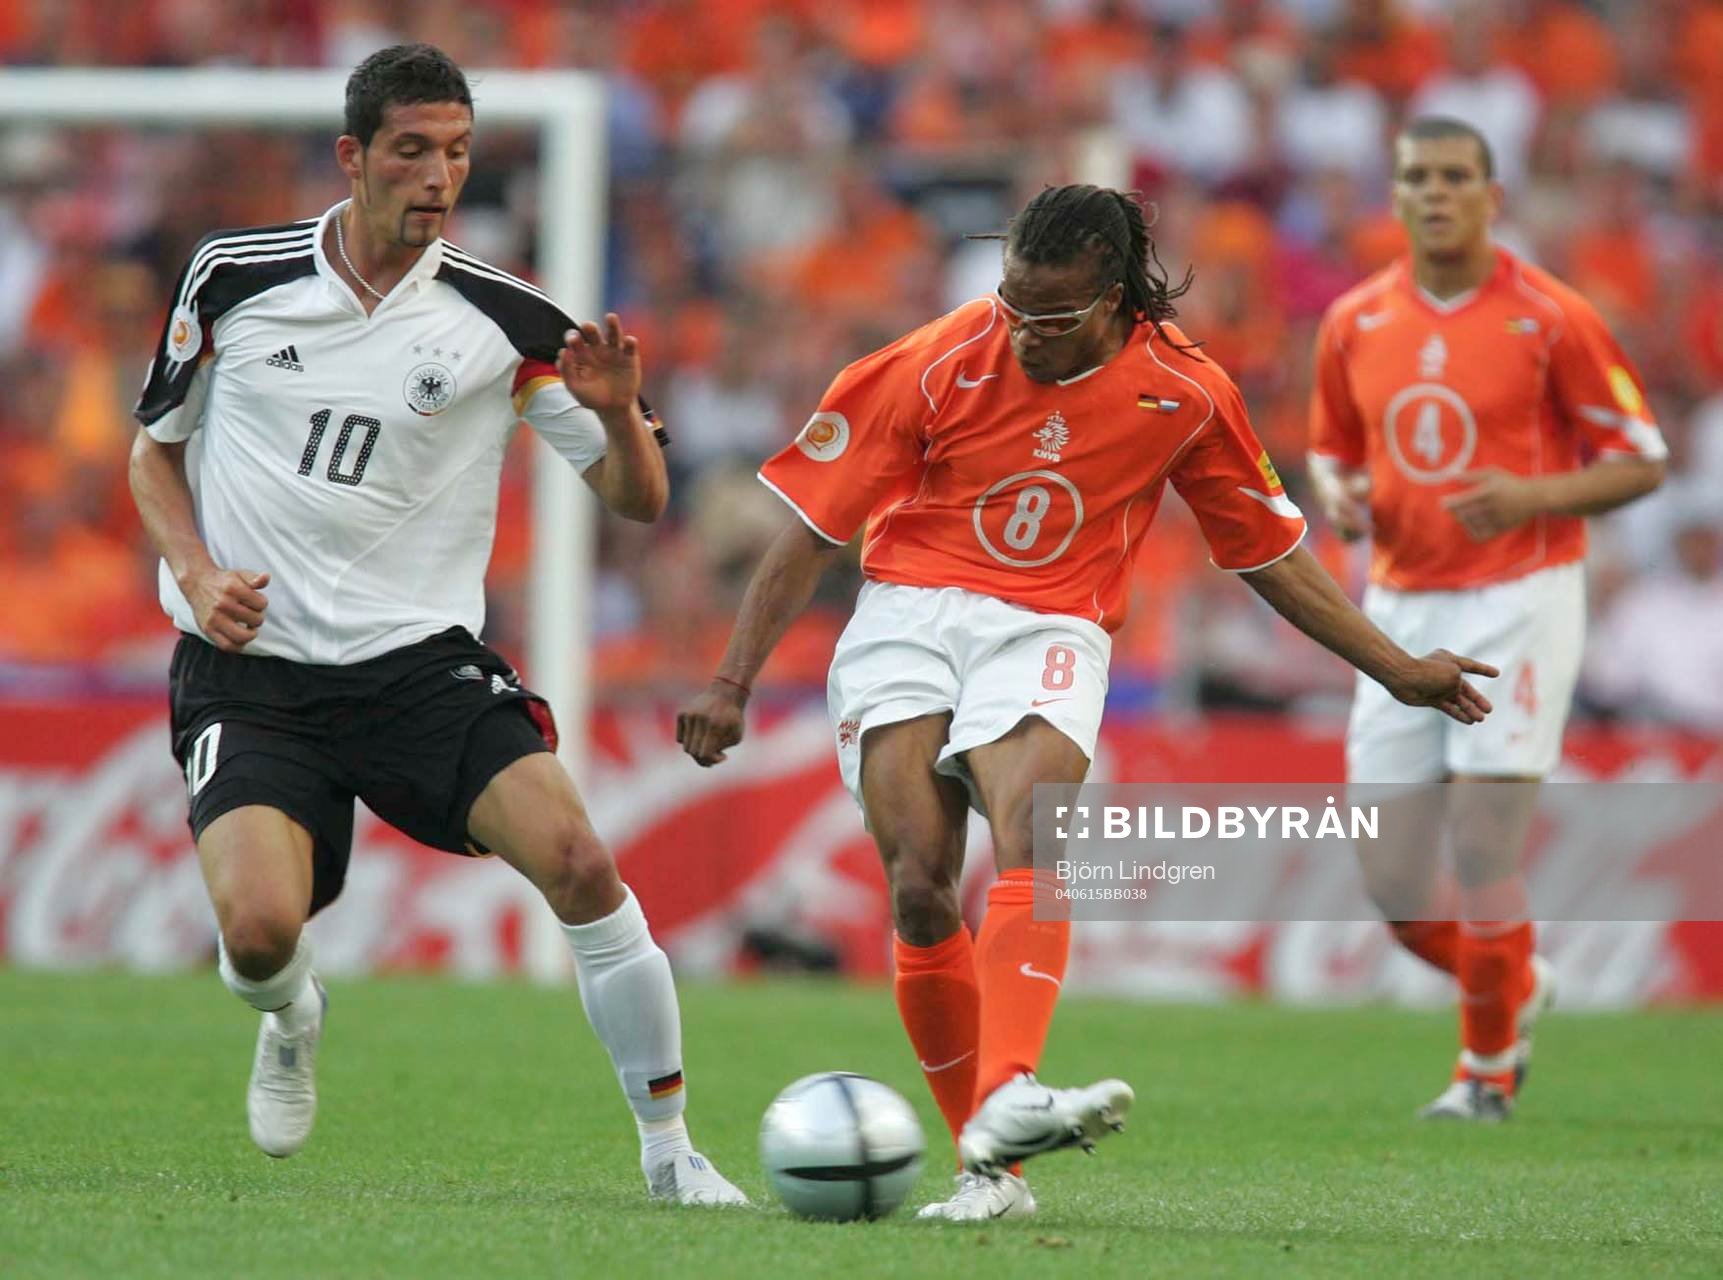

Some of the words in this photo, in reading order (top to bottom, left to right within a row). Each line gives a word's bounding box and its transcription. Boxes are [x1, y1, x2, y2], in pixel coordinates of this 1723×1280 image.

[266, 357, 304, 373] adidas
[297, 408, 382, 487] 10
[1032, 448, 1061, 463] KNVB
[1412, 402, 1444, 465] 4
[1003, 485, 1050, 551] 8
[1041, 645, 1076, 691] 8
[1515, 662, 1537, 716] 4
